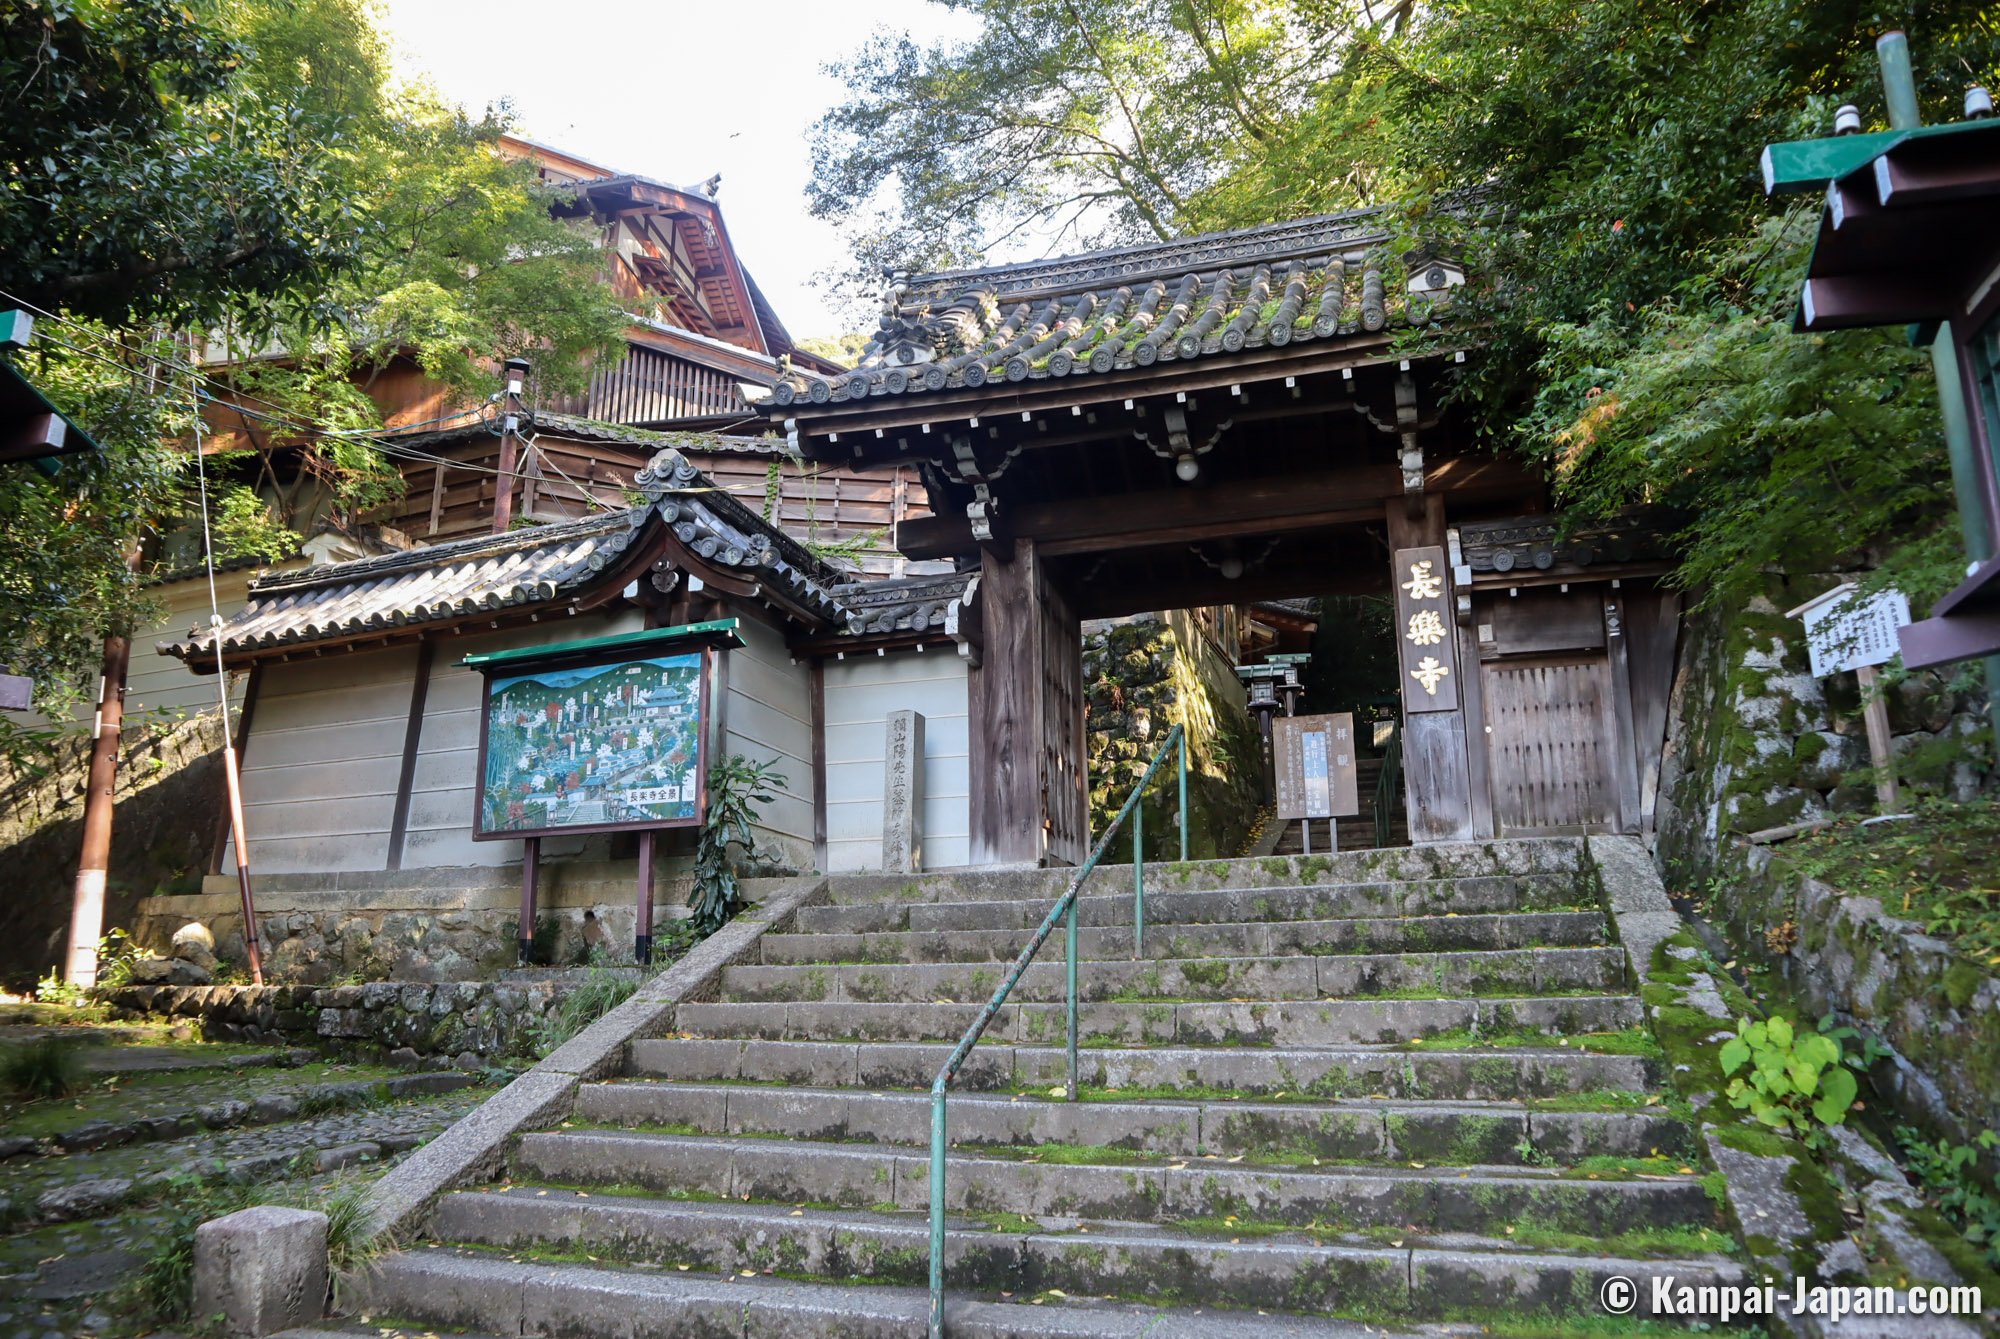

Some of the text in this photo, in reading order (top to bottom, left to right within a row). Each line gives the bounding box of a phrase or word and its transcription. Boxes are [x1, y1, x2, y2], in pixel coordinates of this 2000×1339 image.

[1401, 560, 1449, 696] 長樂寺
[629, 788, 677, 803] 長楽寺全景
